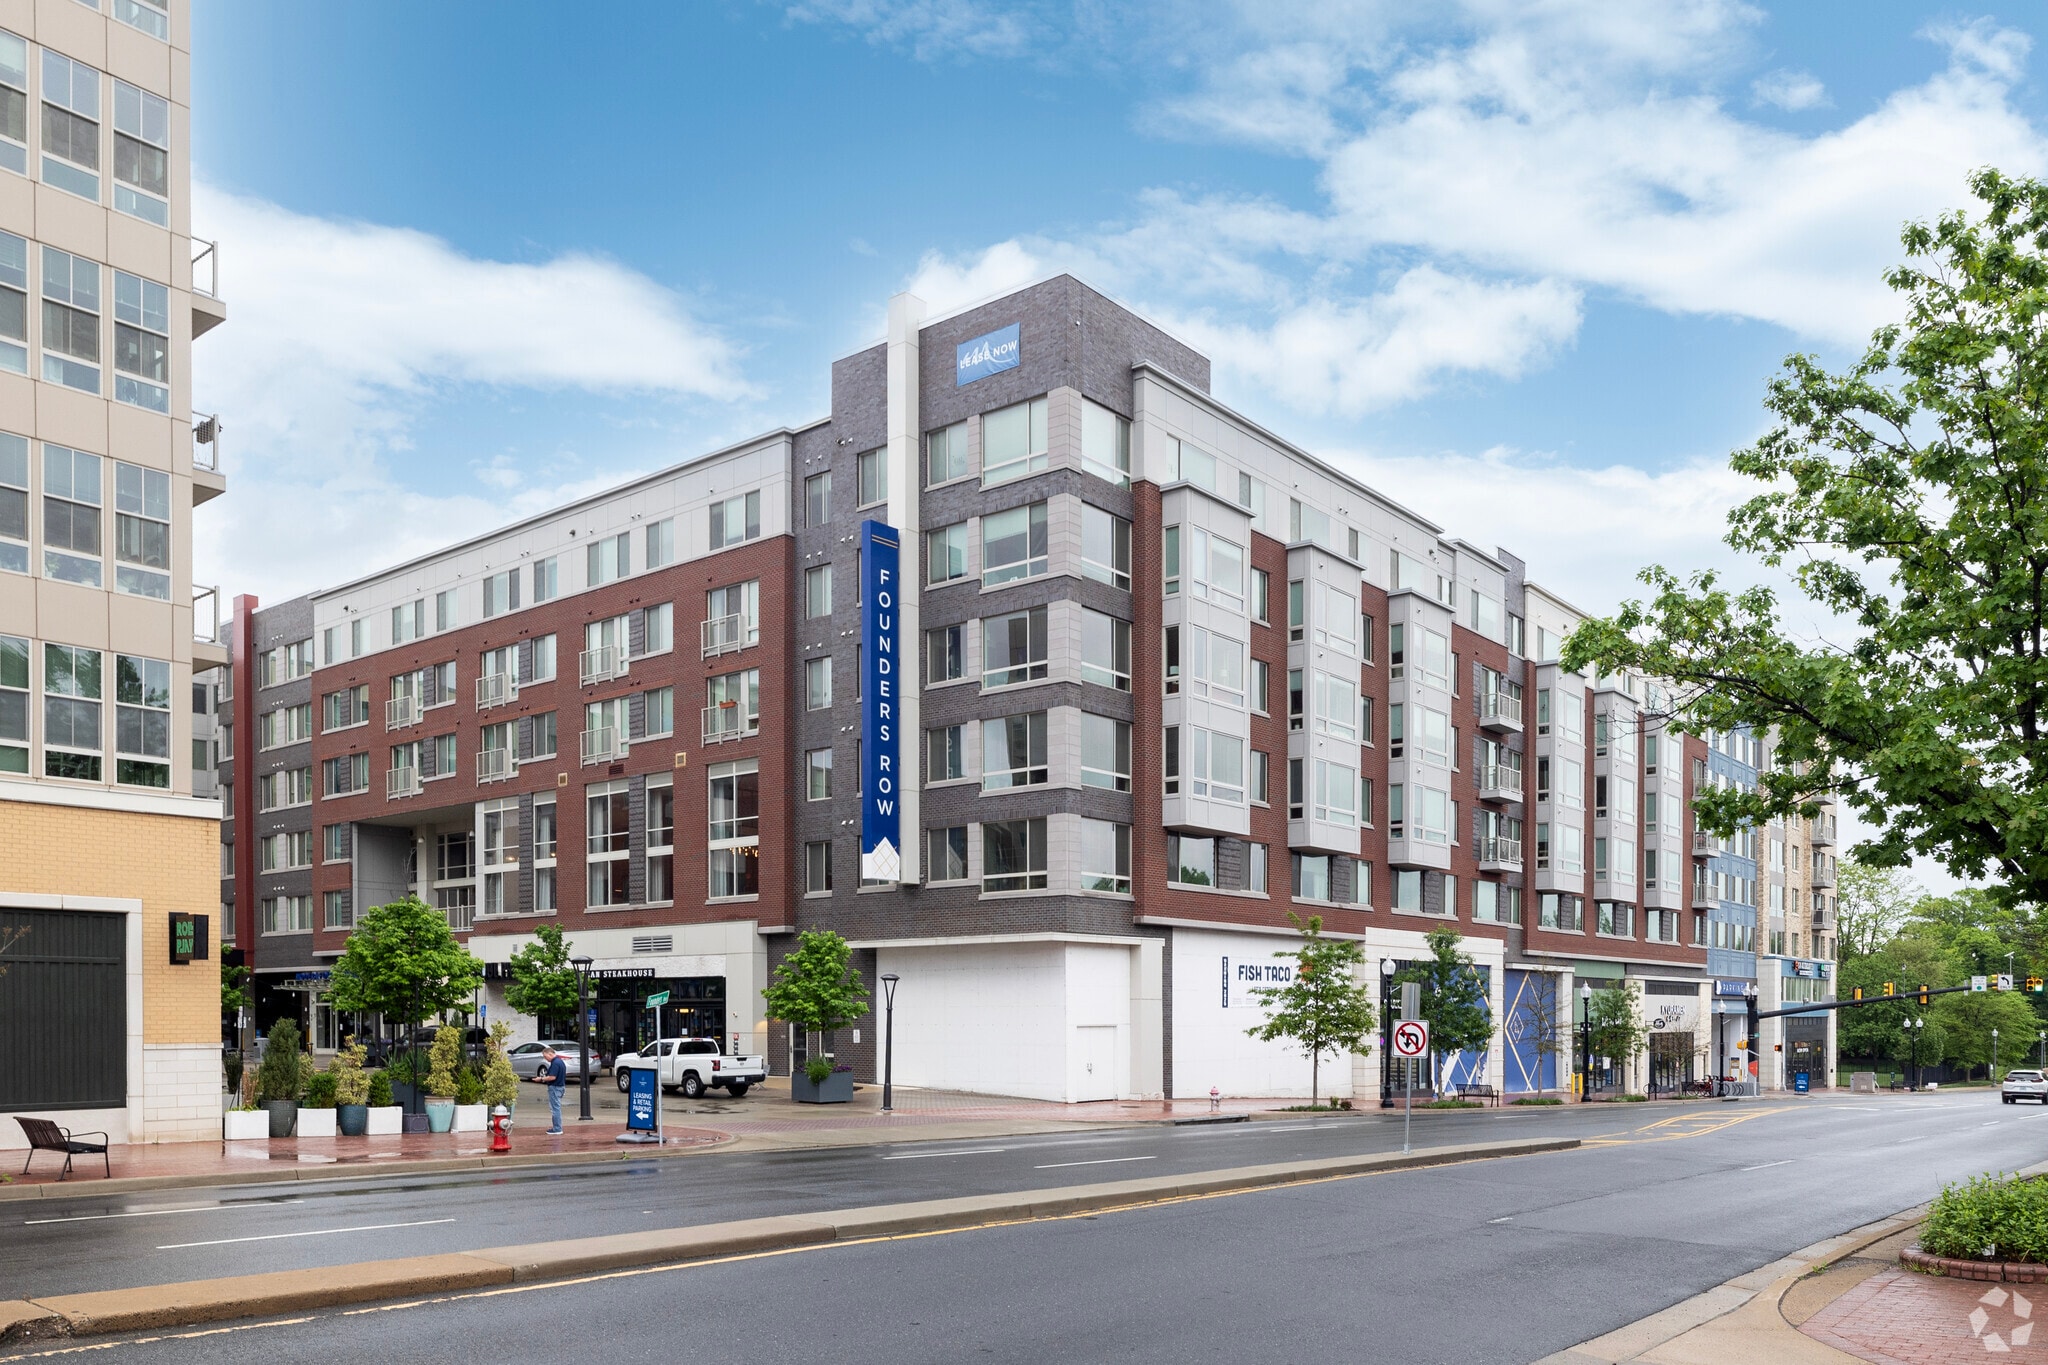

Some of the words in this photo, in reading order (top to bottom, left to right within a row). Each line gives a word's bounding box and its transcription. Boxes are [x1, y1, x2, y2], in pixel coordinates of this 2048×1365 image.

[960, 350, 990, 369] LEASE
[993, 340, 1018, 357] NOW
[879, 568, 891, 742] FOUNDERS
[877, 755, 893, 816] ROW
[603, 969, 653, 978] STEAKHOUSE
[1238, 965, 1262, 981] FISH
[1264, 966, 1291, 982] TACO
[632, 1104, 652, 1112] PARKING
